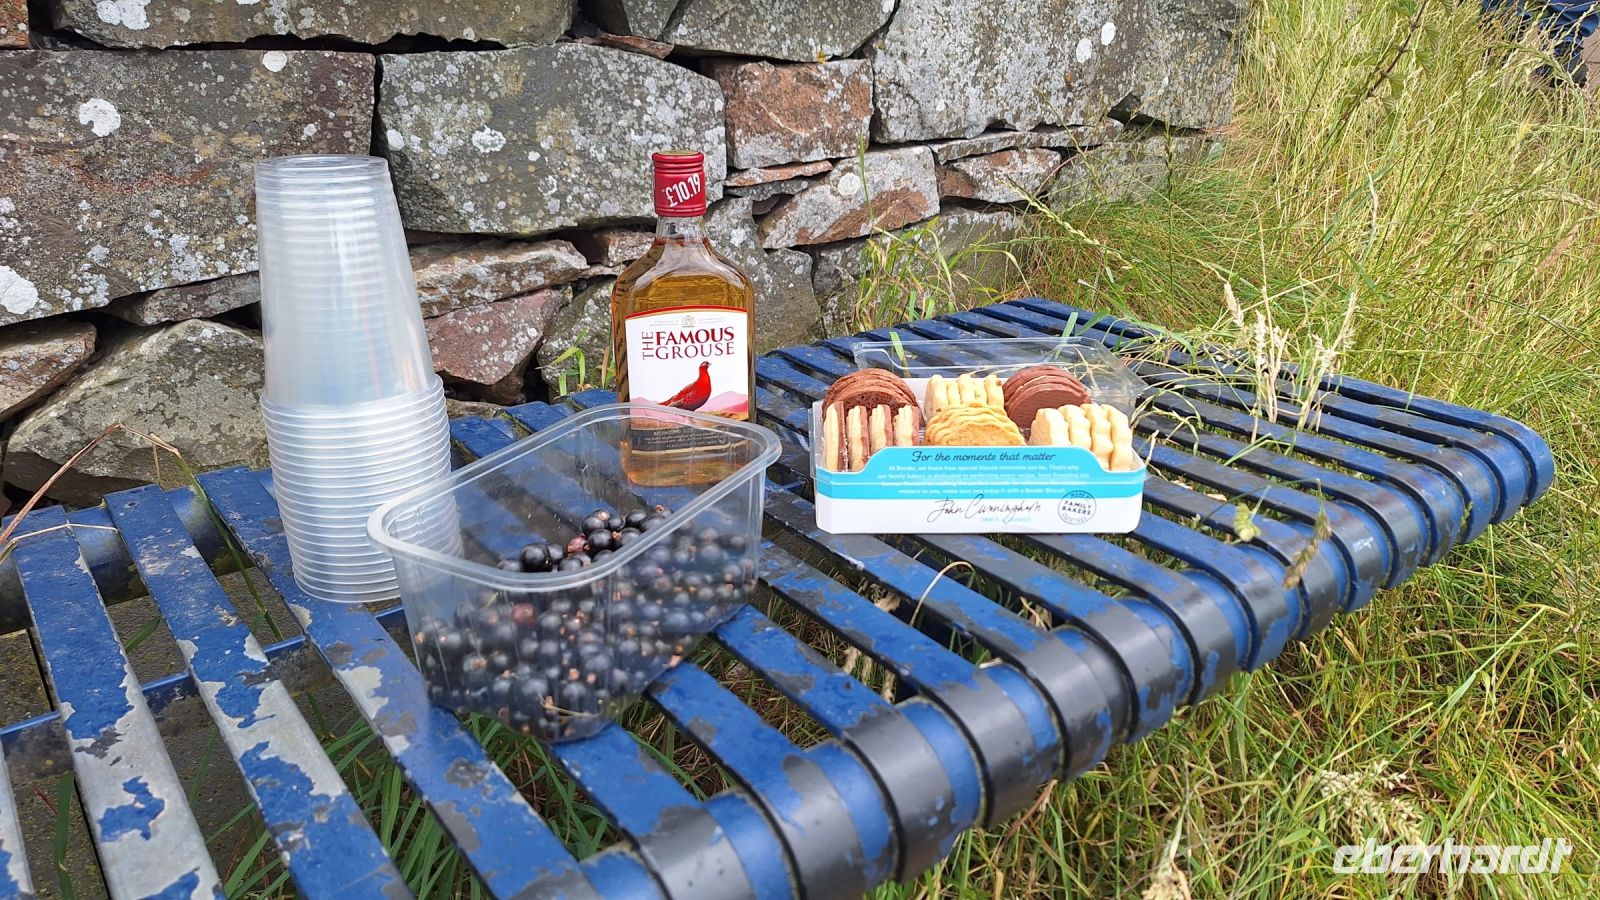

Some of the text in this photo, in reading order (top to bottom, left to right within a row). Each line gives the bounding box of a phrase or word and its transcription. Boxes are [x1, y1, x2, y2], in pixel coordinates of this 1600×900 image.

[665, 173, 701, 208] £10.19
[641, 331, 654, 360] THE
[655, 326, 735, 346] FAMOUS
[655, 341, 735, 360] GROUSE
[911, 450, 1056, 462] For the moments that matter
[1064, 500, 1092, 509] FAMILY
